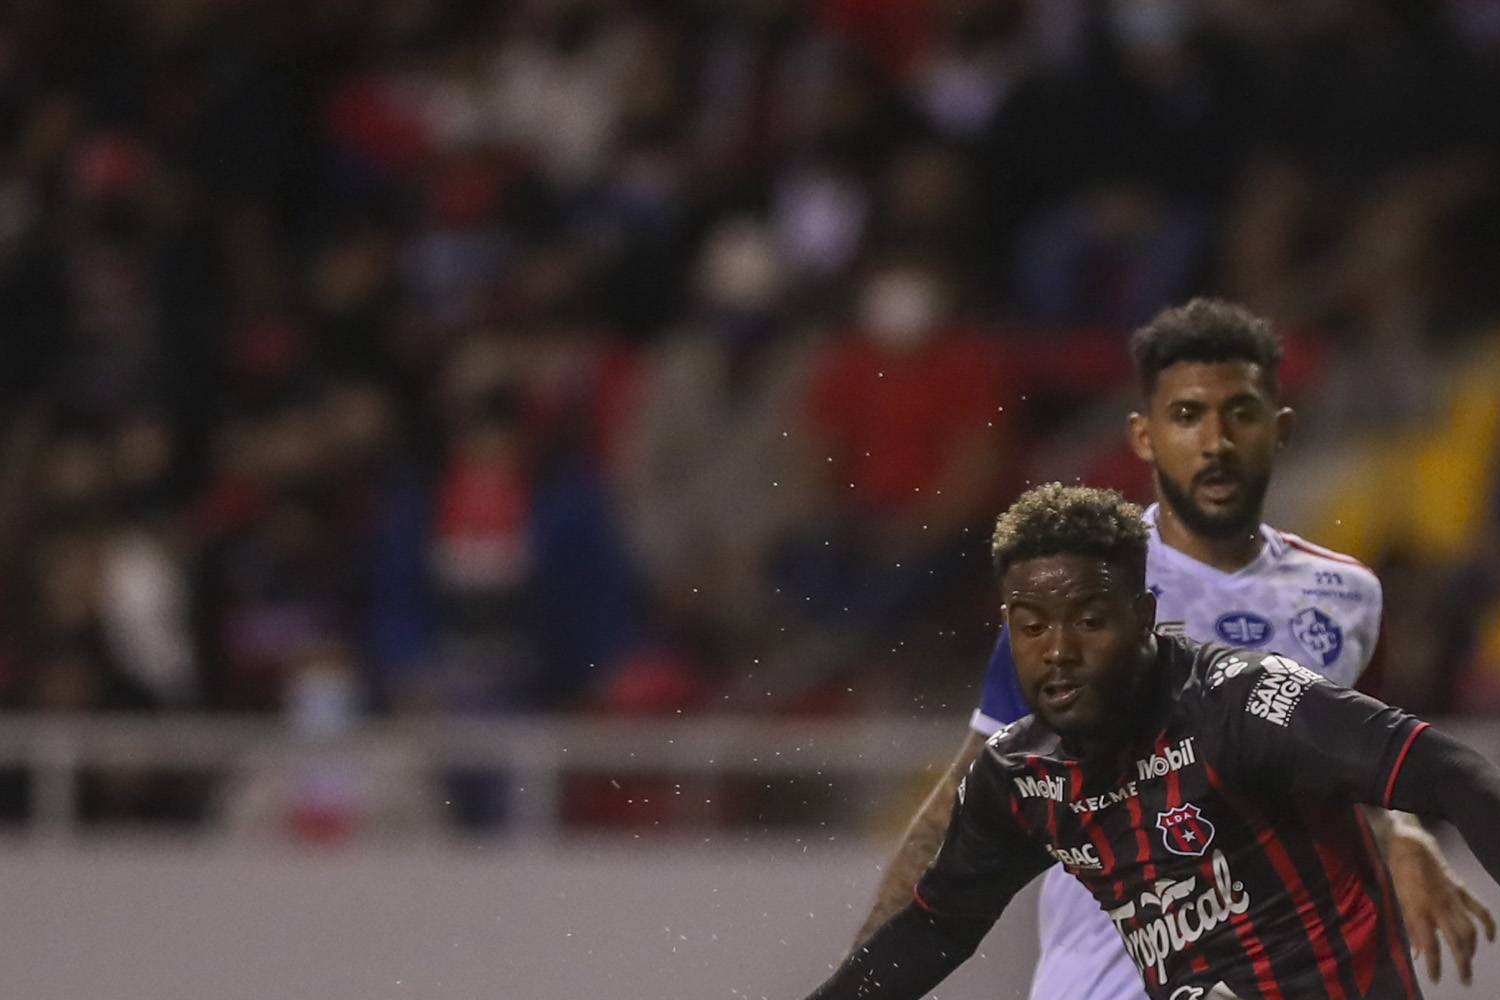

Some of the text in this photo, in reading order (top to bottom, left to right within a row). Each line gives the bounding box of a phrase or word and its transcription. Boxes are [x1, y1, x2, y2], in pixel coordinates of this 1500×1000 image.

[1250, 673, 1287, 718] SAN
[1137, 737, 1196, 781] Mobil
[1014, 775, 1066, 802] Mobil
[1069, 781, 1139, 813] KELME
[1165, 812, 1193, 827] LDA
[1056, 843, 1100, 866] BAC
[1108, 848, 1250, 985] Tropical
